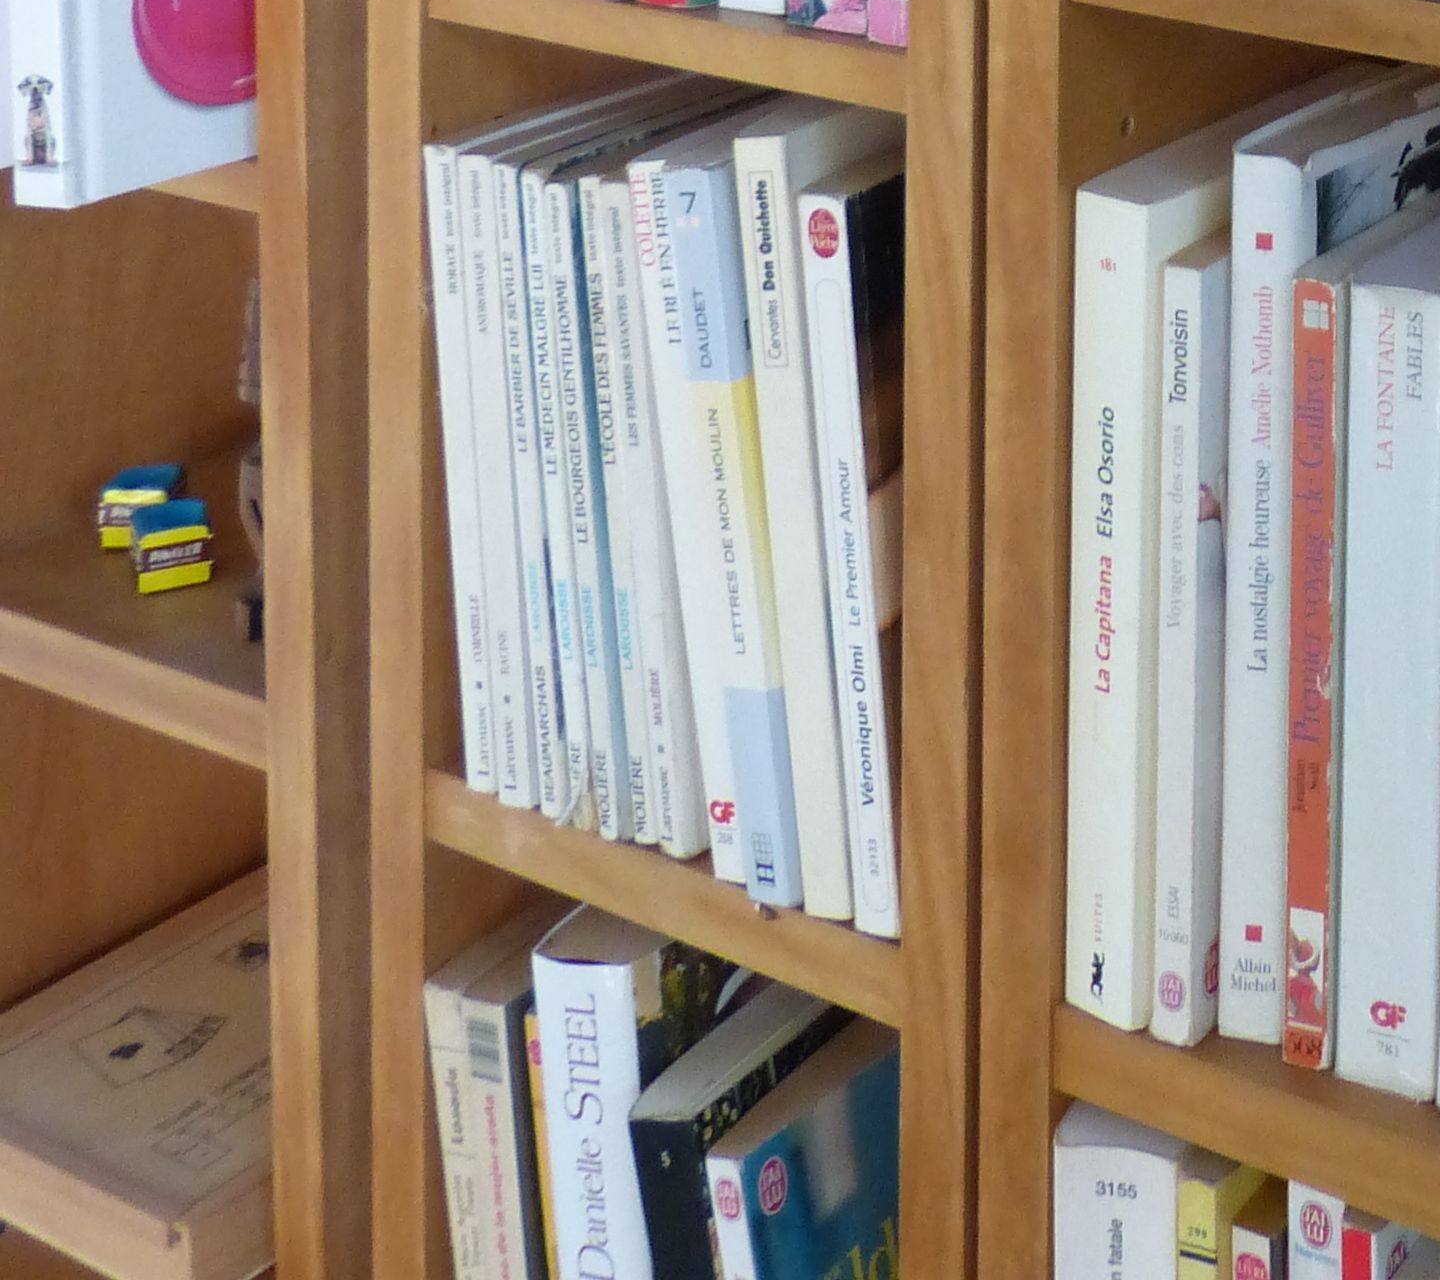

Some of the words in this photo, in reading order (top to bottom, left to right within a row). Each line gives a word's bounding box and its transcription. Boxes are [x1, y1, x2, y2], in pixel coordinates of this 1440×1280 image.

[1168, 309, 1191, 405] Tonvoisin
[1250, 284, 1275, 377] Nothomb
[1097, 406, 1116, 486] Osorio
[1249, 381, 1274, 449] Amélie
[1096, 492, 1116, 539] Elsa
[1249, 458, 1274, 550] heureuse
[1096, 555, 1117, 663] Capitana
[1247, 554, 1275, 642] nostalgie
[849, 644, 867, 694] Olmi
[1095, 668, 1113, 694] La
[1247, 647, 1271, 673] La
[852, 700, 877, 806] Véronique
